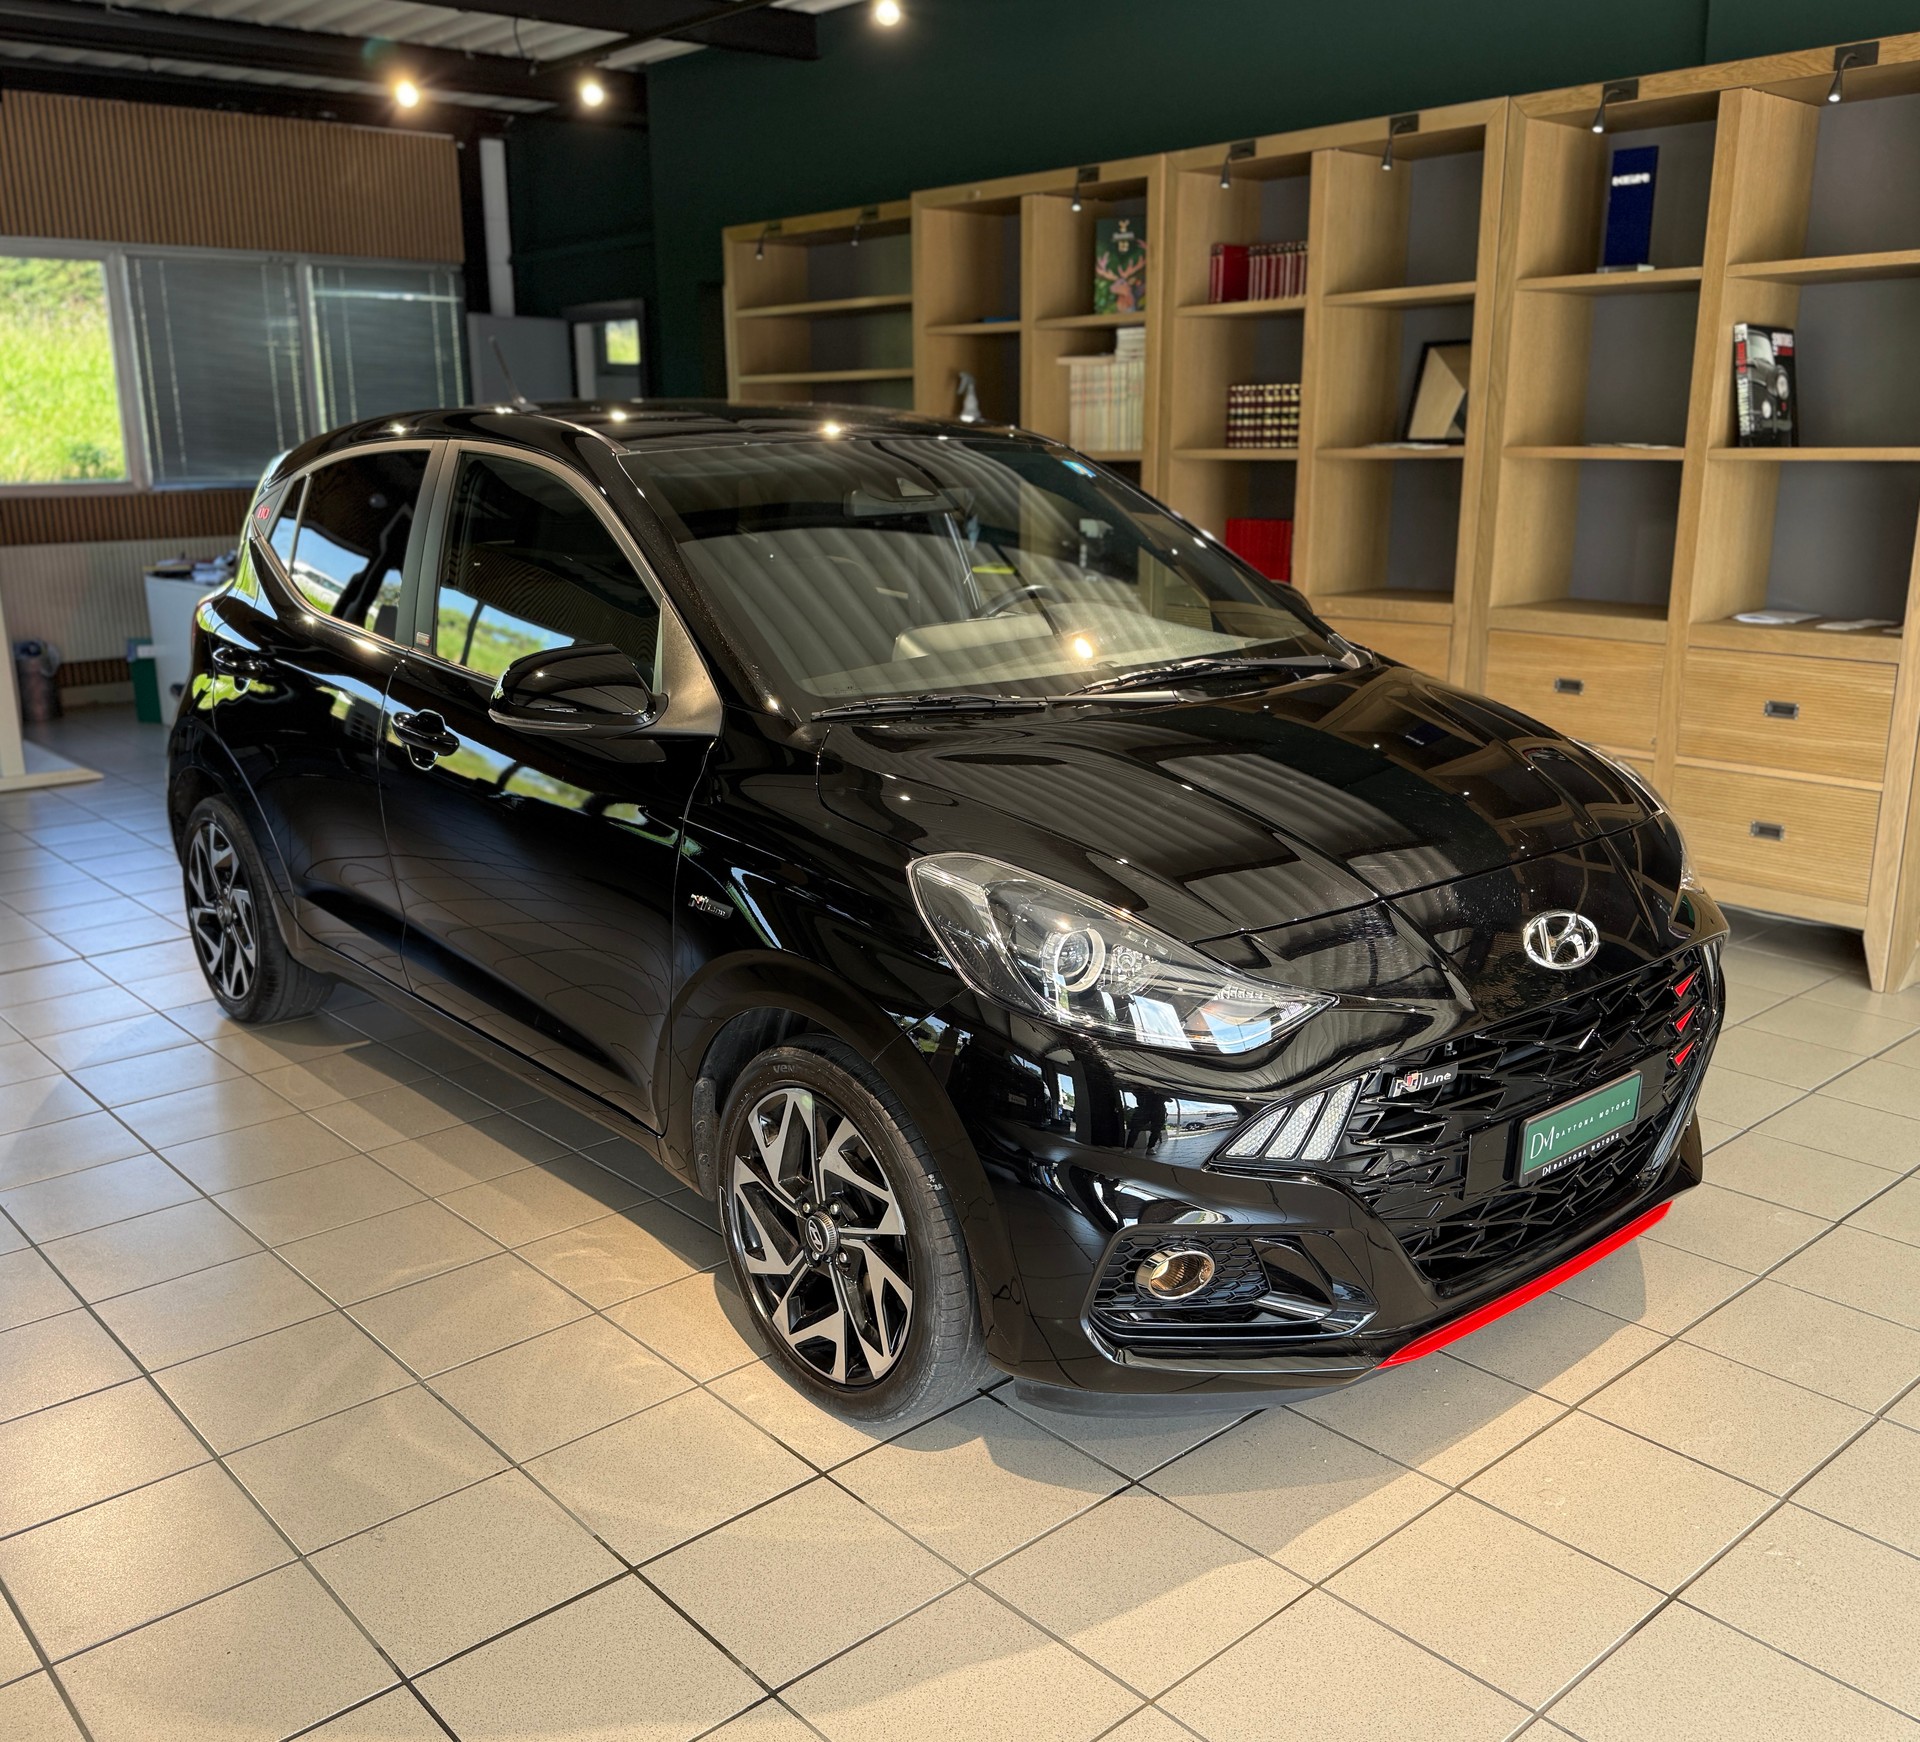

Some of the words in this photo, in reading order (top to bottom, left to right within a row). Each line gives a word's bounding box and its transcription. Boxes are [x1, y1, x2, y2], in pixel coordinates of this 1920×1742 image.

[1424, 1072, 1451, 1086] Line
[1555, 1116, 1594, 1139] DAYTONA
[1599, 1098, 1631, 1119] MOTORS
[1591, 1132, 1619, 1151] MOTORS
